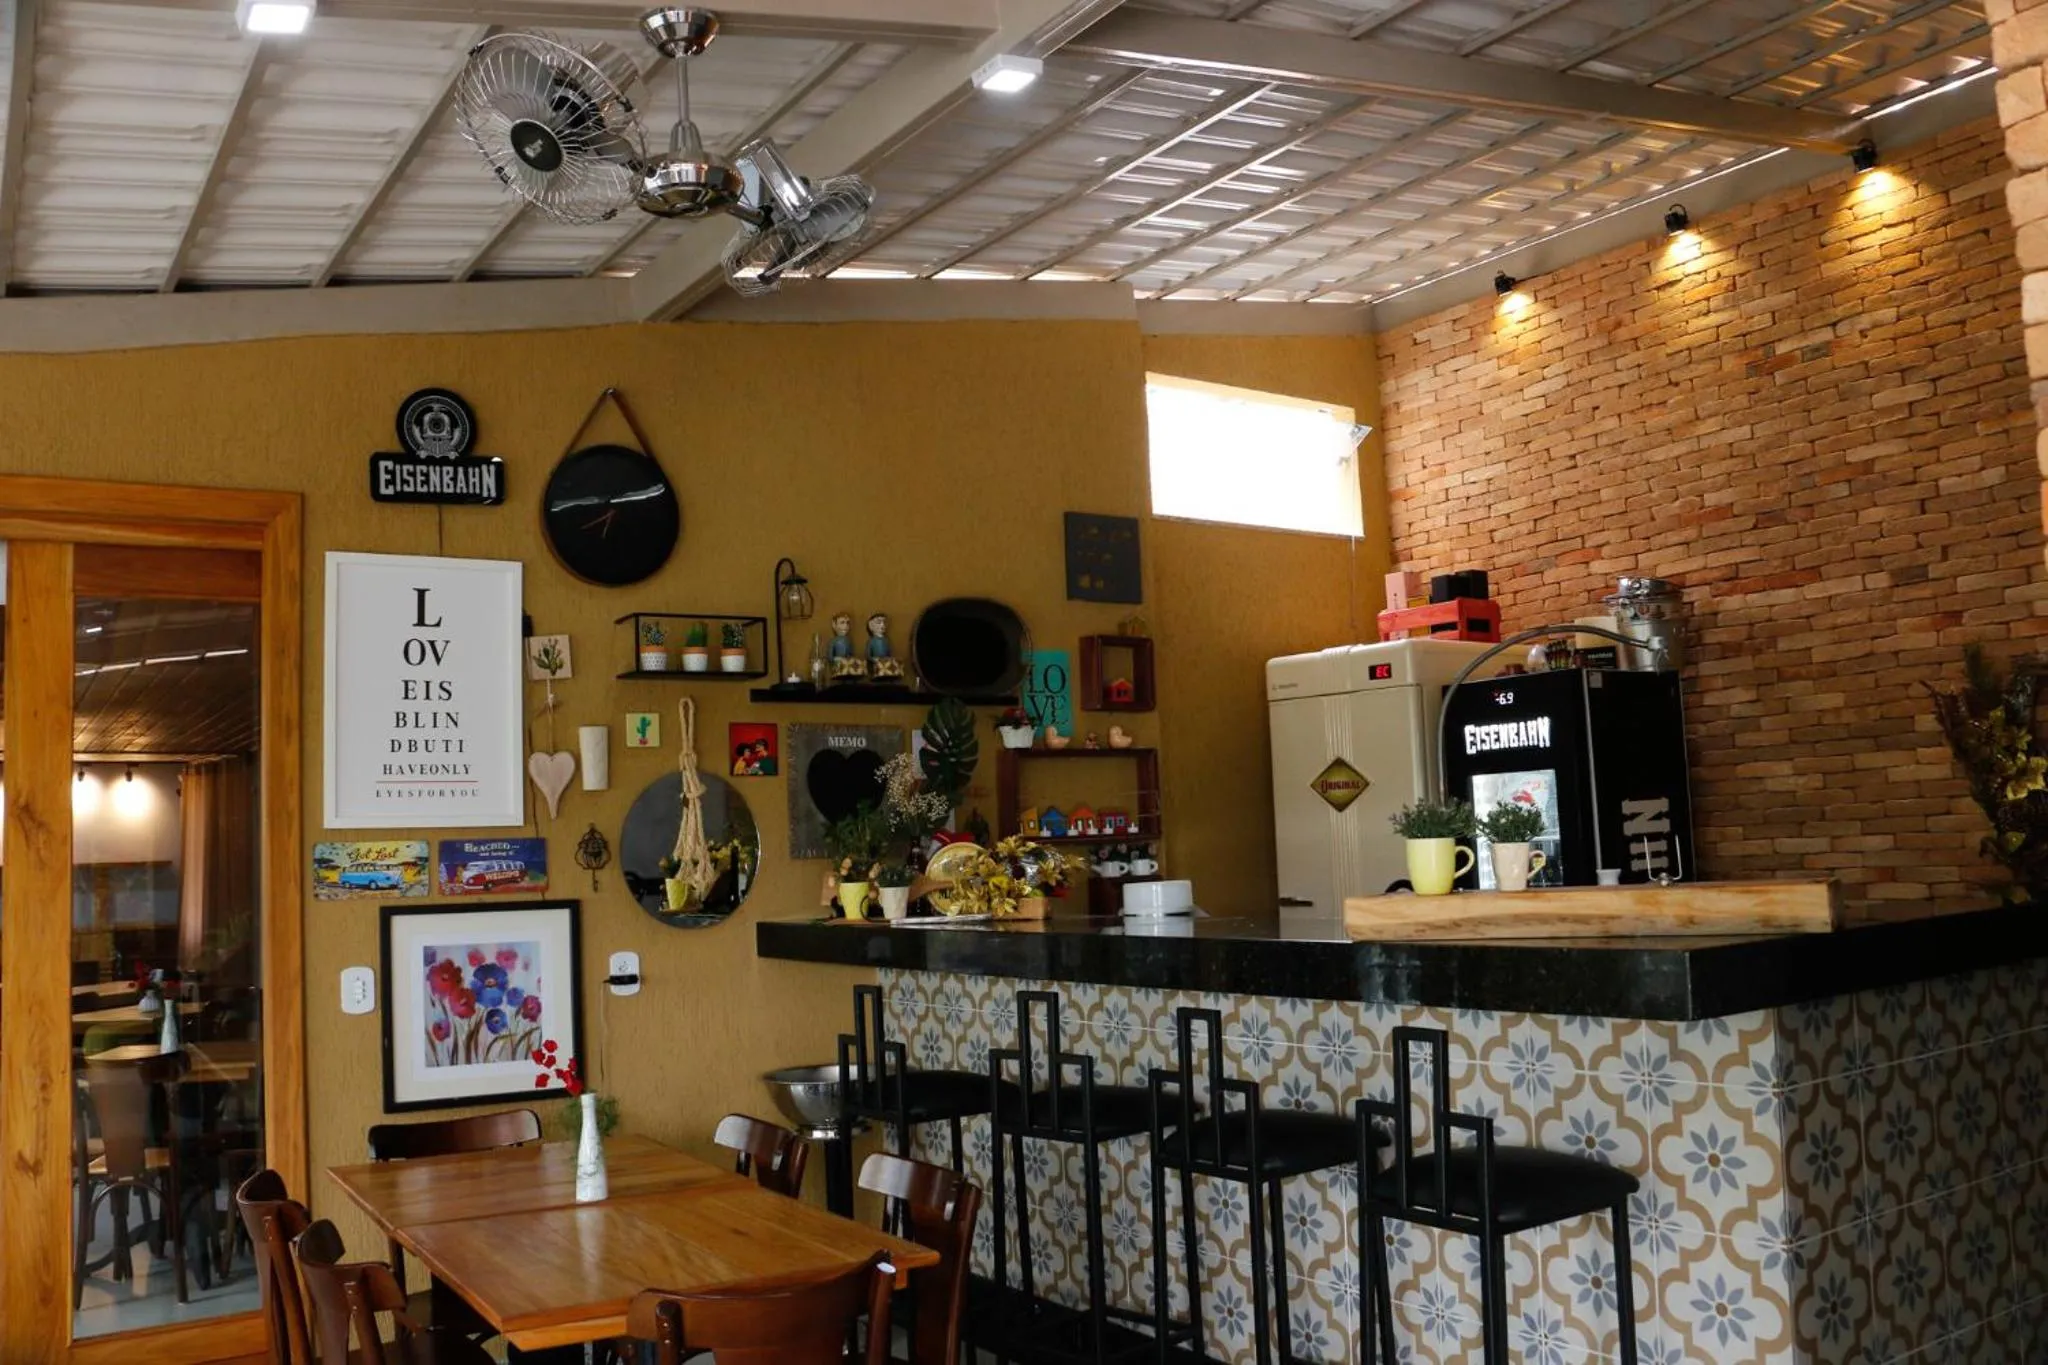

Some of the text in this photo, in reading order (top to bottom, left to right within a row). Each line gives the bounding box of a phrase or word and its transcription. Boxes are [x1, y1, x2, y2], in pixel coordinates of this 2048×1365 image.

[377, 459, 498, 499] EISENBAHN
[412, 587, 443, 628] L
[402, 638, 451, 667] OV
[401, 679, 453, 701] EIS
[394, 711, 460, 730] BLIN
[828, 736, 867, 748] MEMO
[1464, 715, 1551, 755] EISENBAHN
[389, 738, 464, 754] DBUTI
[382, 763, 472, 777] HAVEONLY
[375, 788, 479, 799] EYESFORYOU
